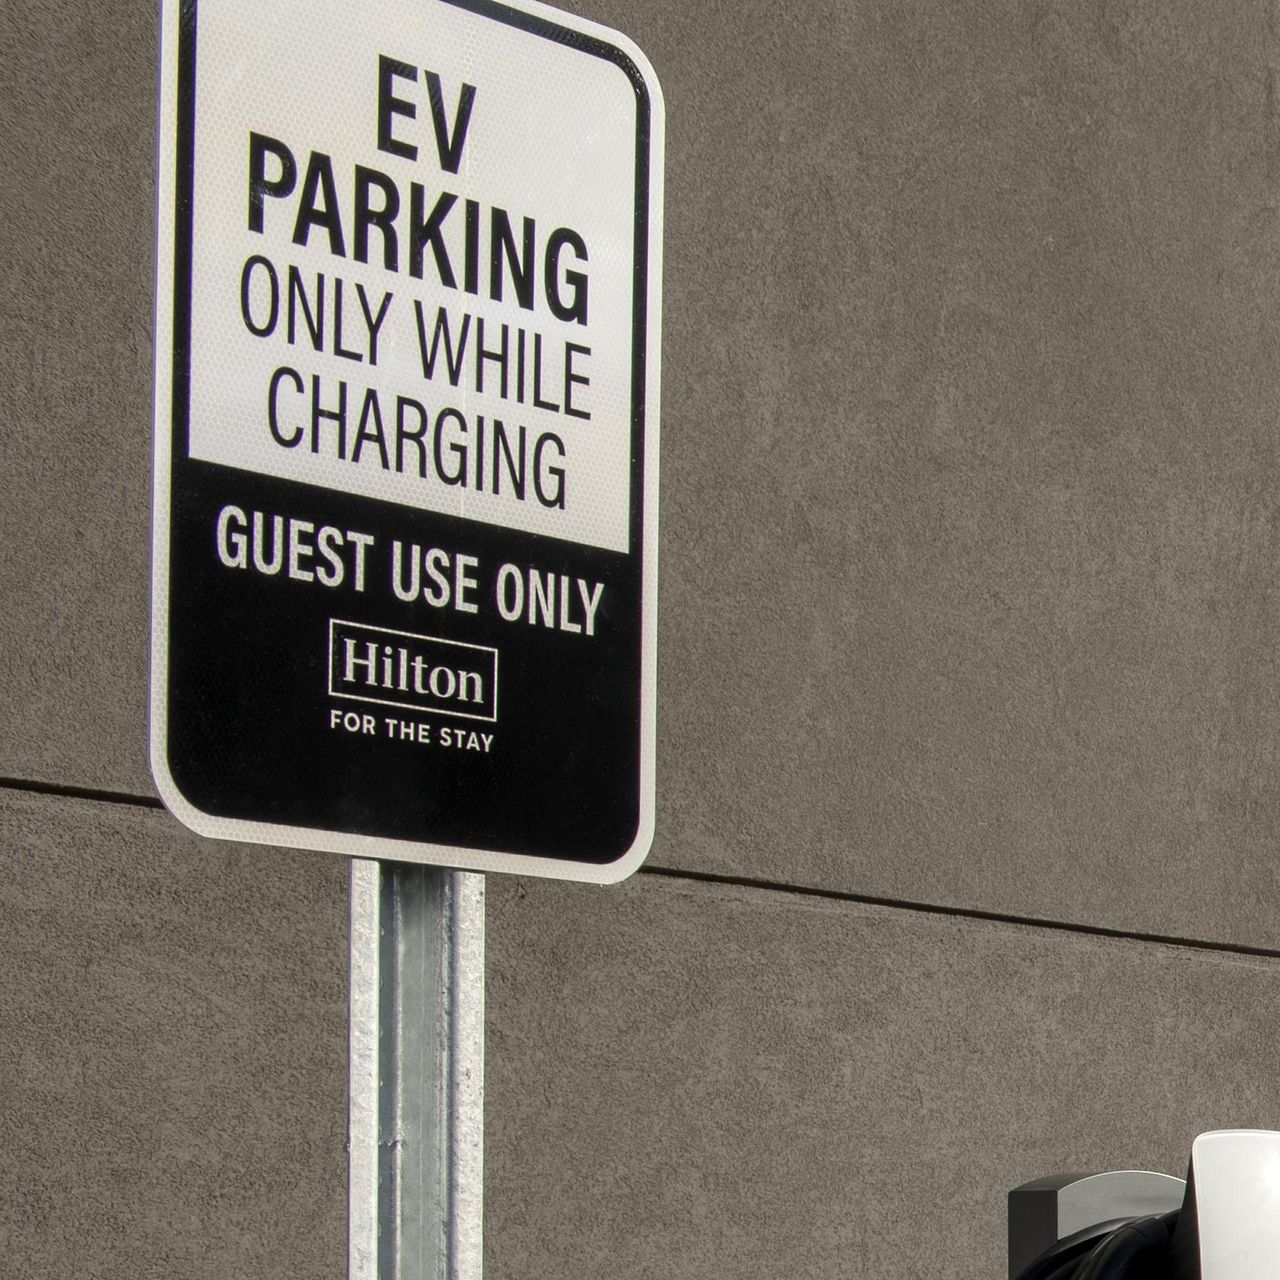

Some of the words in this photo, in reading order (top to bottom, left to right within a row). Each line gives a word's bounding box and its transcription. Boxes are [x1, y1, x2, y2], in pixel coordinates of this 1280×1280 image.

[377, 53, 477, 174] EV
[248, 130, 589, 326] PARKING
[240, 254, 394, 366] ONLY
[414, 299, 591, 421] WHILE
[268, 366, 566, 510] CHARGING
[216, 505, 374, 591] GUEST
[392, 539, 479, 614] USE
[496, 562, 604, 636] ONLY
[330, 709, 376, 735] FOR
[385, 718, 430, 743] THE
[440, 727, 494, 752] STAY
[343, 638, 484, 703] Hilton
